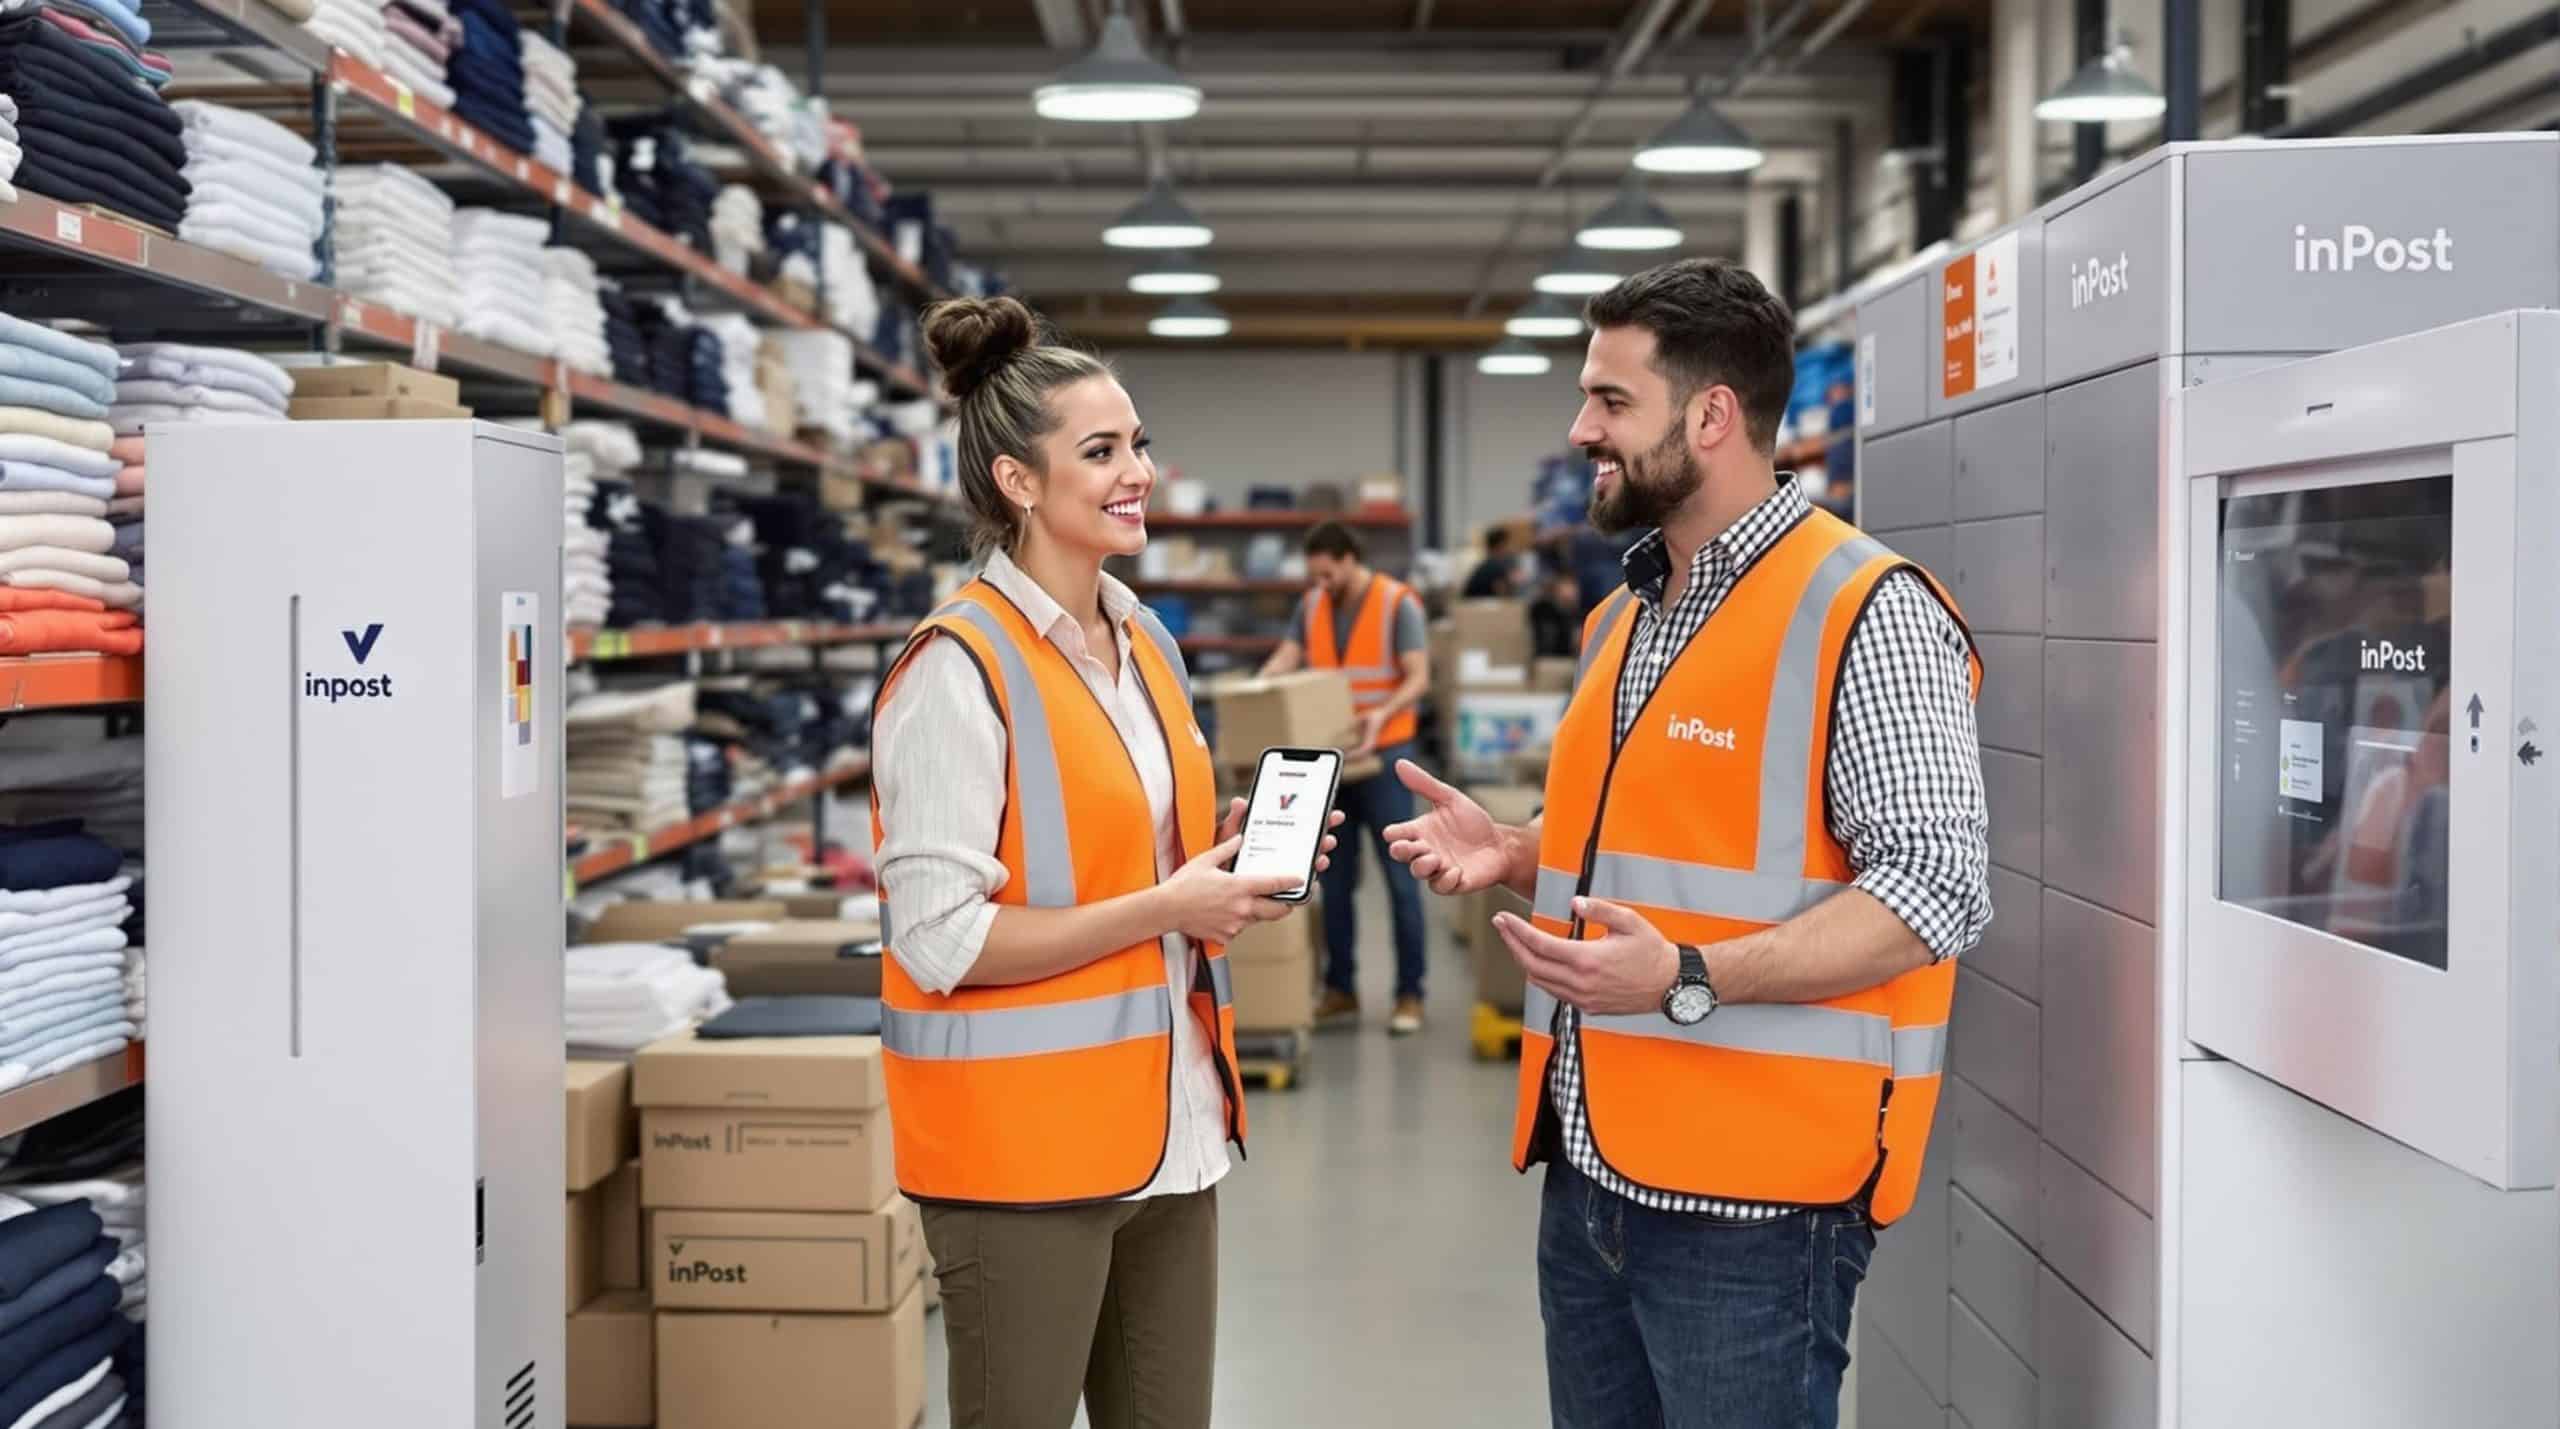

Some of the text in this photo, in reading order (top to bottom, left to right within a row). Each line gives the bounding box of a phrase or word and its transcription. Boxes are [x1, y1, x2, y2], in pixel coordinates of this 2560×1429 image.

[2295, 224, 2454, 272] inPost
[2071, 250, 2129, 309] inPost
[2361, 640, 2427, 671] inPost
[305, 672, 393, 704] inpost
[1667, 713, 1736, 751] inPost
[654, 1133, 711, 1151] inPost
[668, 1261, 748, 1284] inPost
